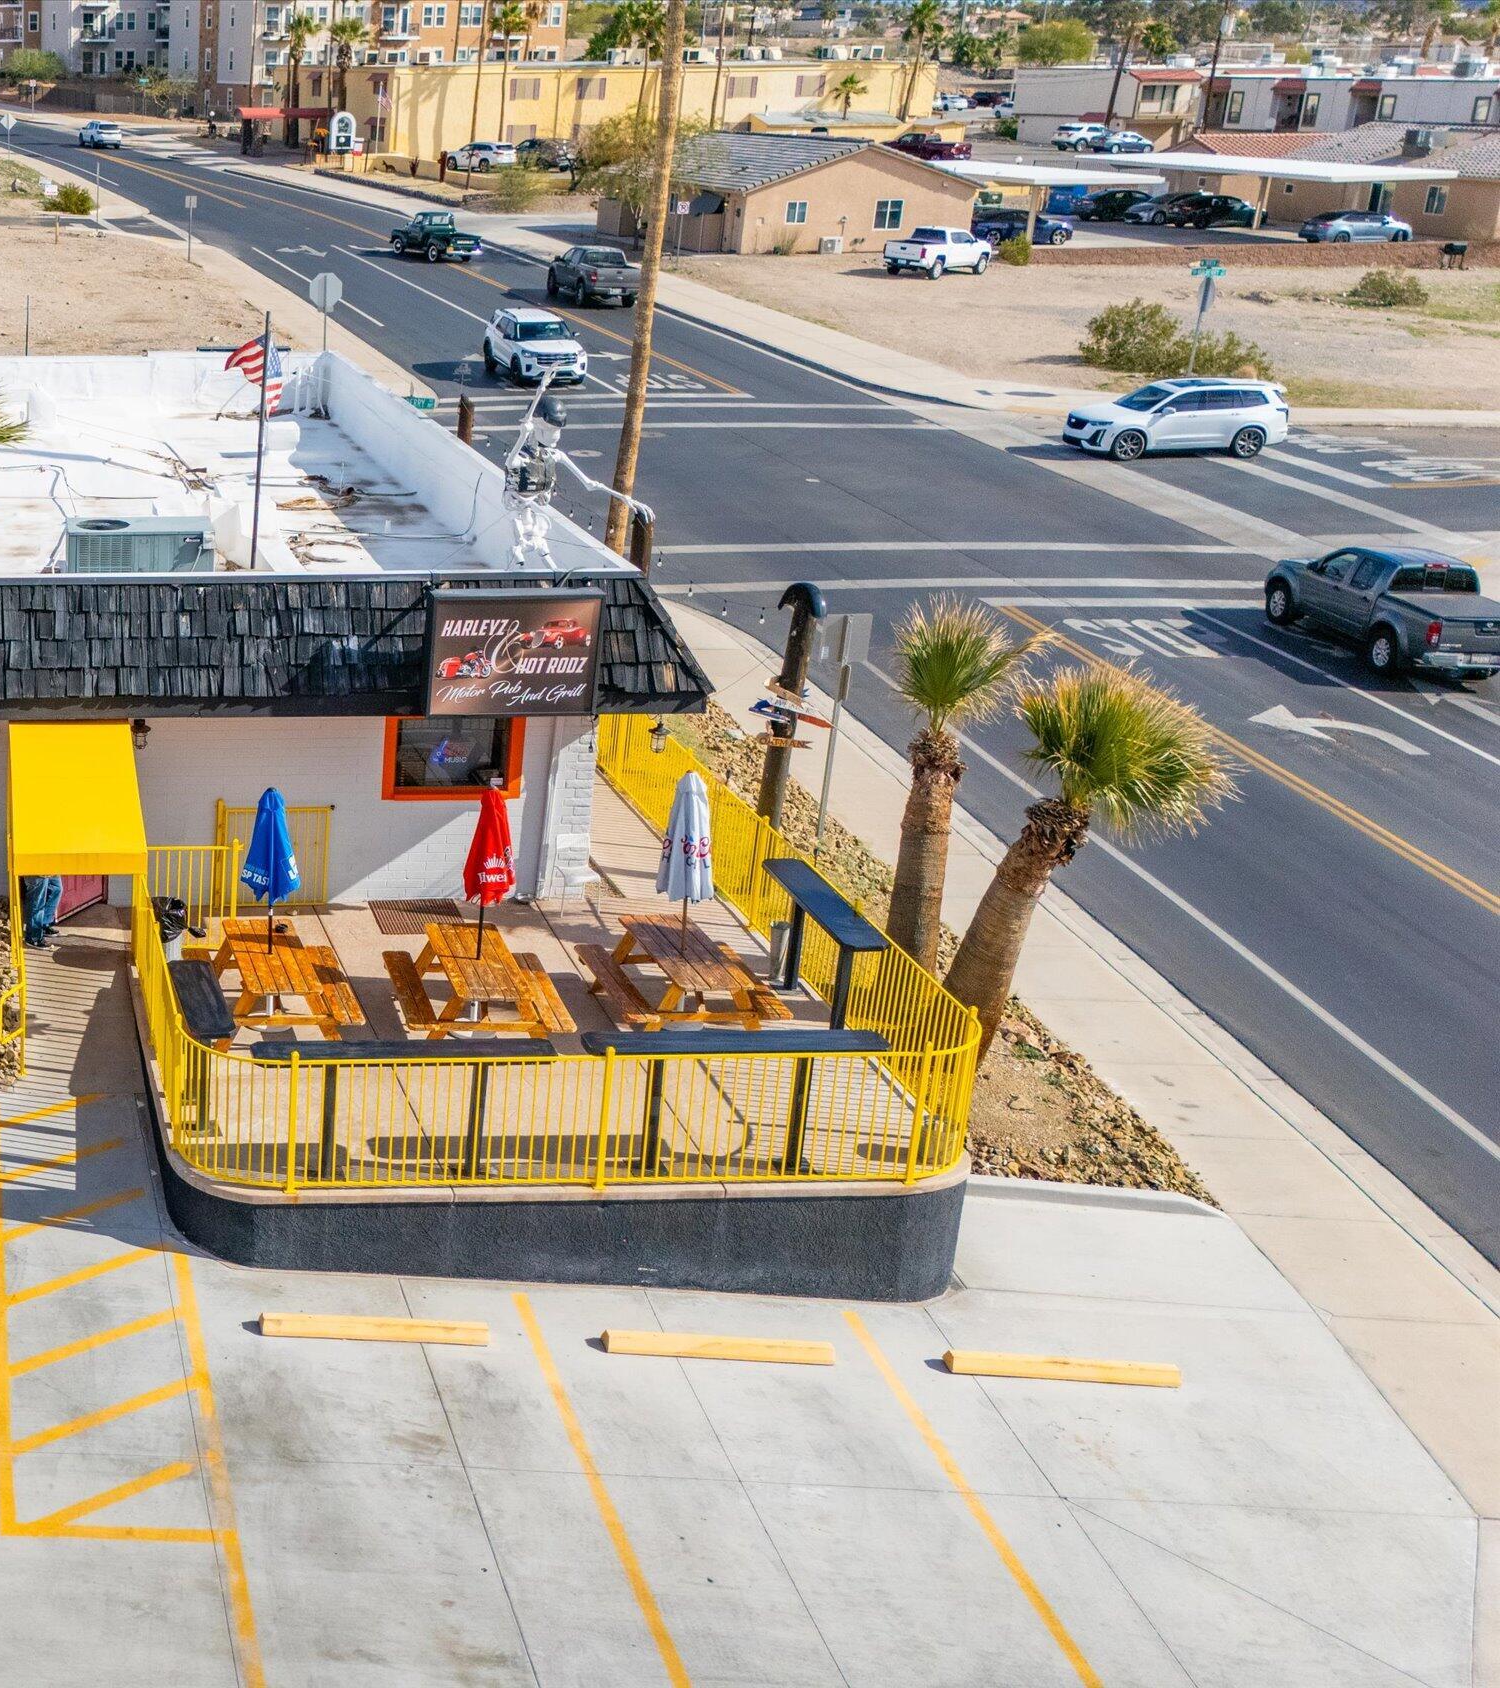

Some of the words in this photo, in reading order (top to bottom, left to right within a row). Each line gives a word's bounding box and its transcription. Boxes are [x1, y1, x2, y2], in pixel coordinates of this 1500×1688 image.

[441, 618, 509, 637] HARLEYZ
[515, 657, 546, 675] HOT
[546, 657, 588, 674] RODZ
[436, 684, 486, 704] Motor
[489, 680, 522, 699] Pub
[506, 689, 545, 706] And
[545, 683, 587, 704] Grill
[444, 756, 468, 764] MUSIC
